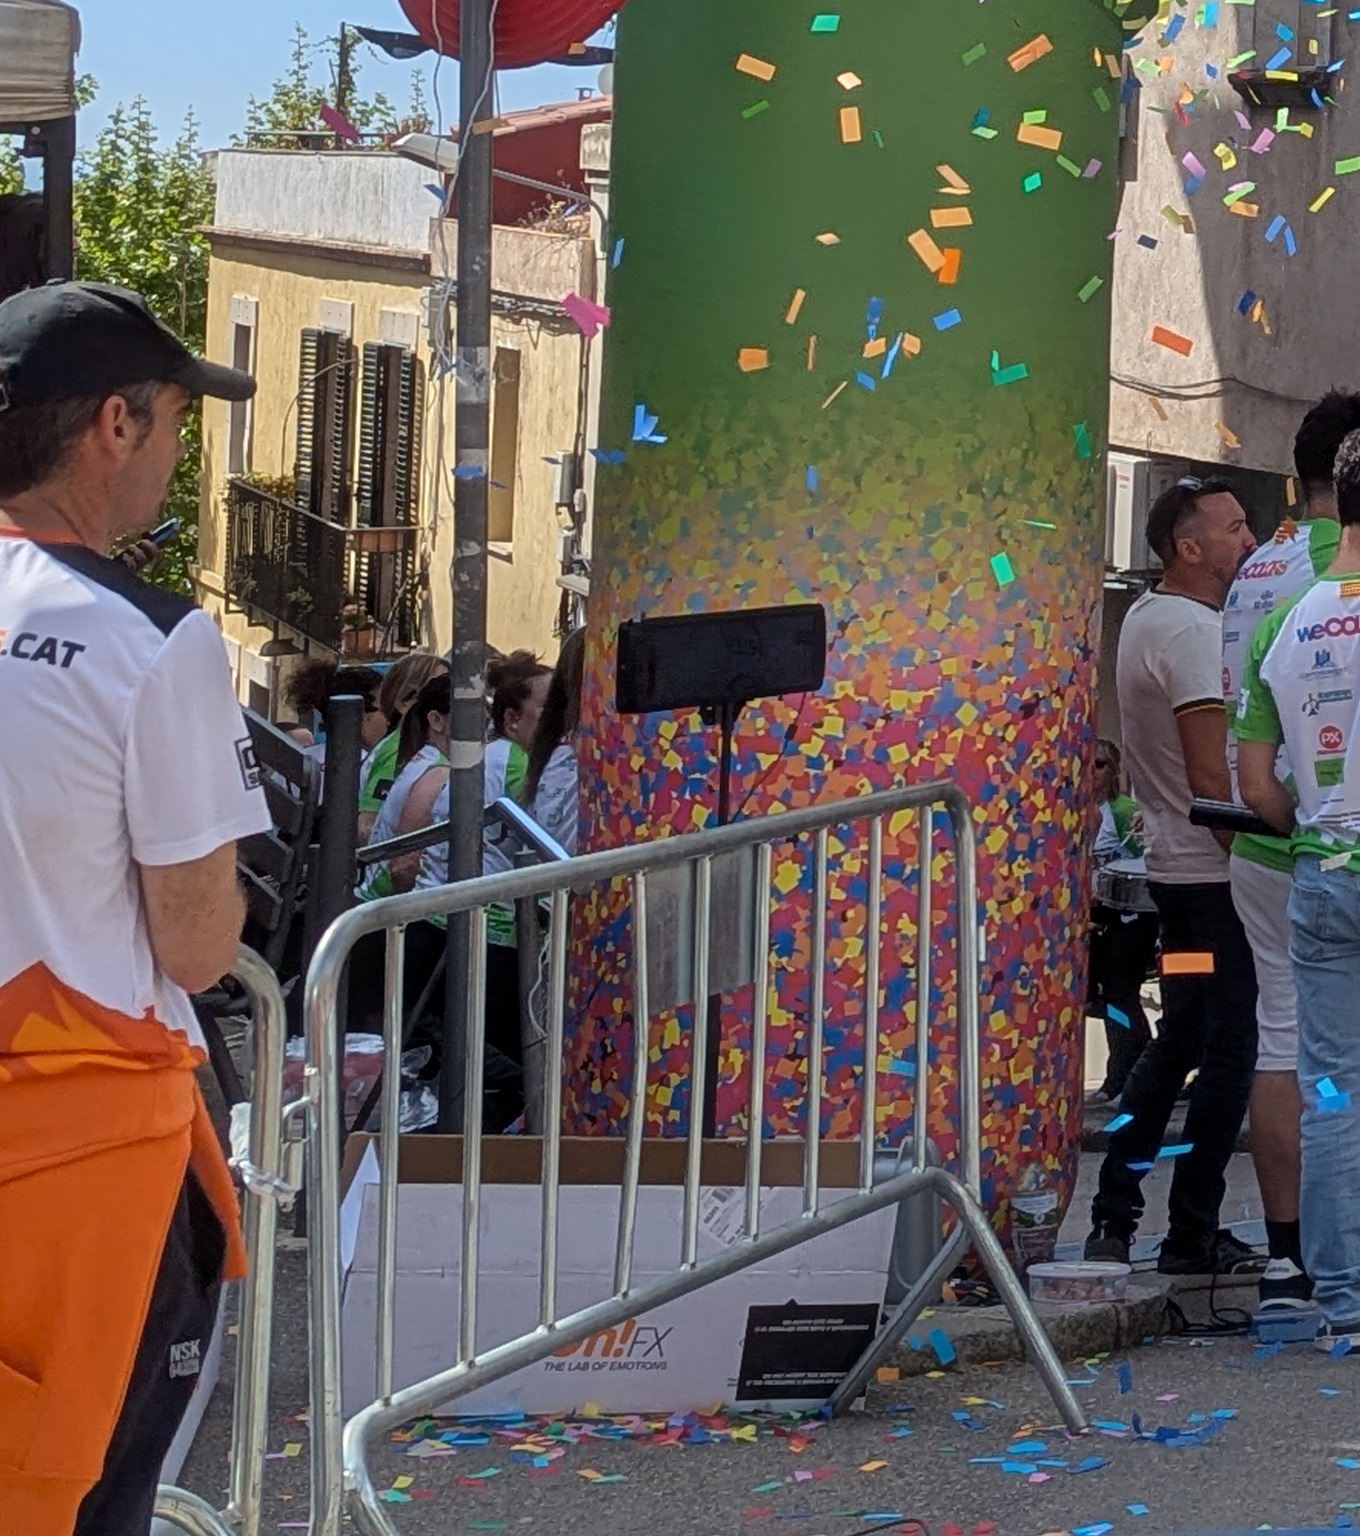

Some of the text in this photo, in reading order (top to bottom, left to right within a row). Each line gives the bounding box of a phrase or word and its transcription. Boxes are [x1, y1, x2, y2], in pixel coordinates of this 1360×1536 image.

[0, 629, 87, 669] .CAT
[544, 1360, 668, 1372] THE LAB OF EMOTIONS
